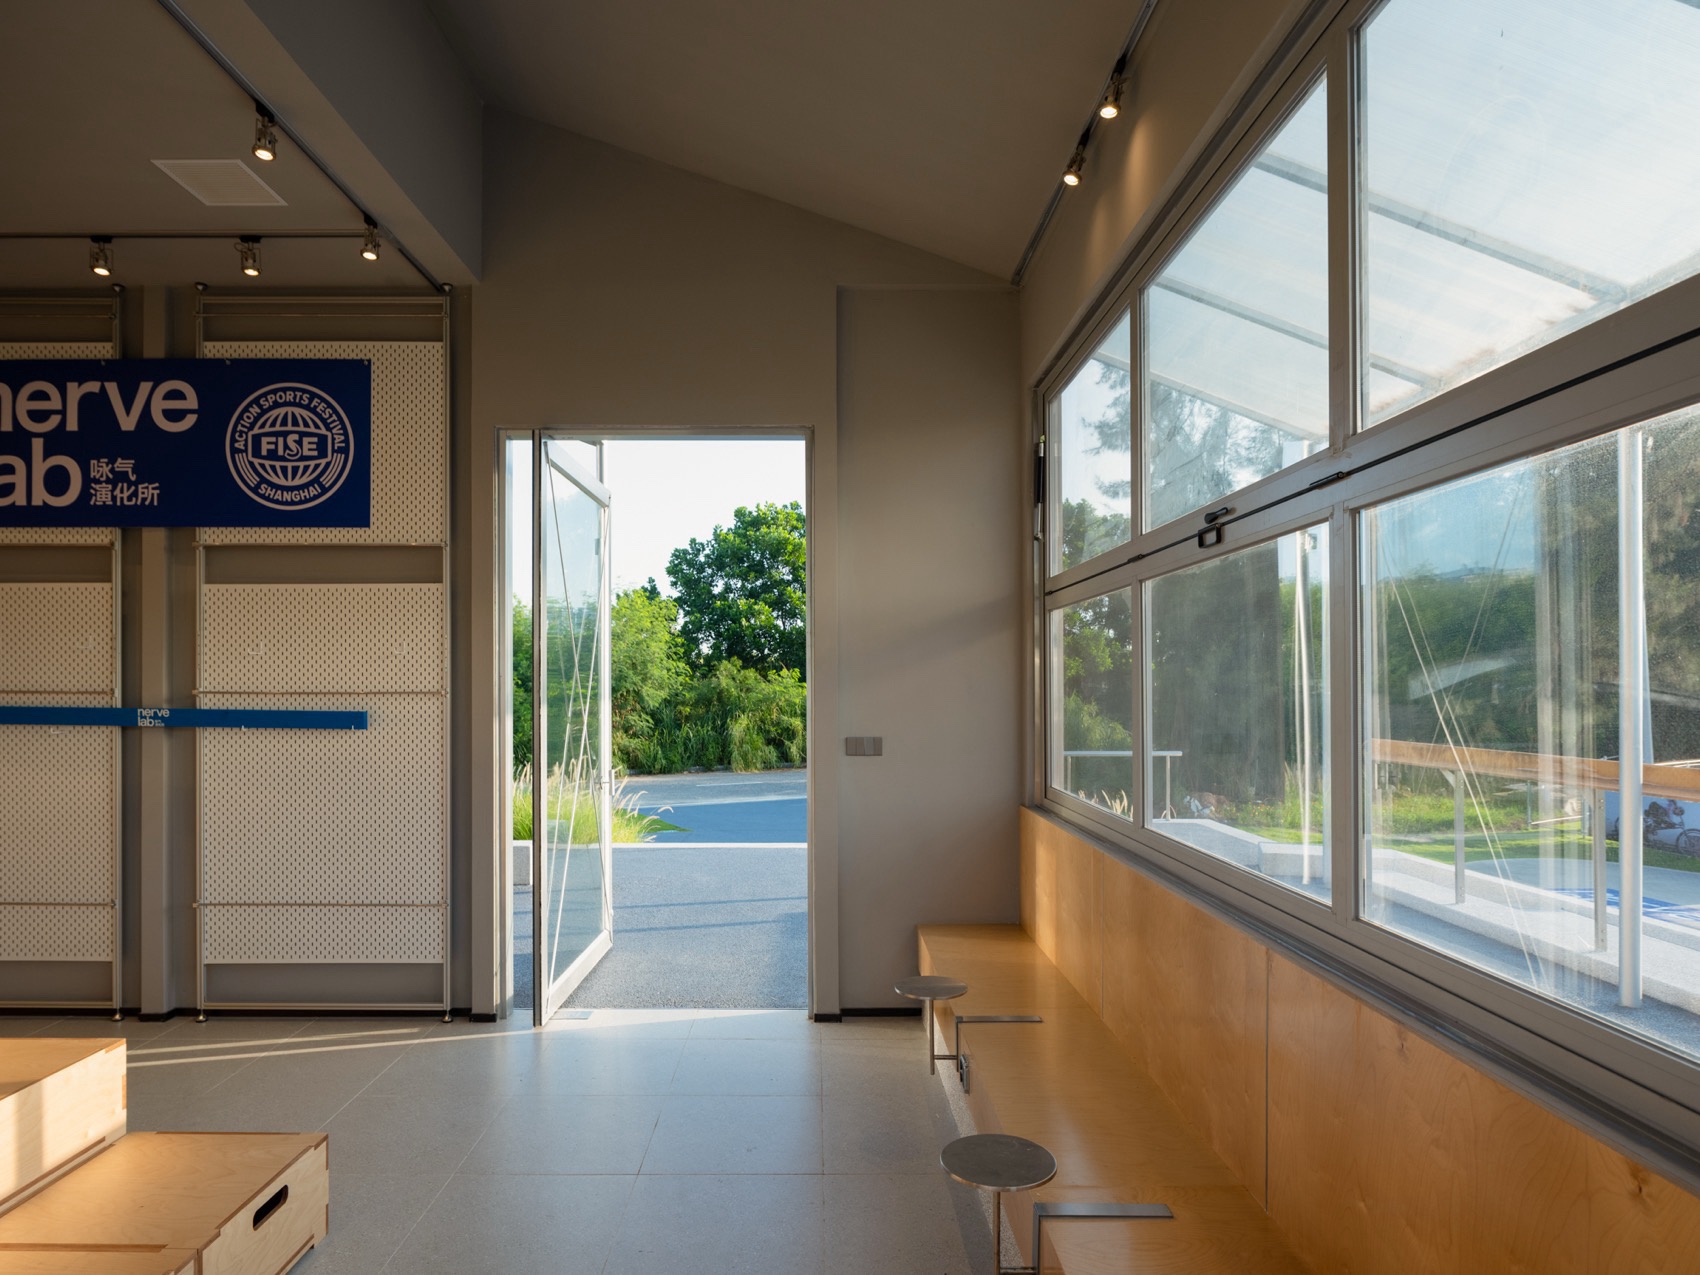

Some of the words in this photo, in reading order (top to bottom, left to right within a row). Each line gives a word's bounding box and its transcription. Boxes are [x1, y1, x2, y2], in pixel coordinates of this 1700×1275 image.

[0, 380, 198, 433] erve
[234, 404, 261, 450] ACTION
[260, 391, 310, 409] SPORTS
[310, 398, 346, 450] FESTIVAL
[261, 434, 319, 460] FISE
[90, 457, 137, 481] 咏气
[90, 482, 160, 506] 演化所
[258, 483, 322, 502] SHANGHAI
[137, 708, 170, 717] nerve
[137, 717, 155, 727] lab
